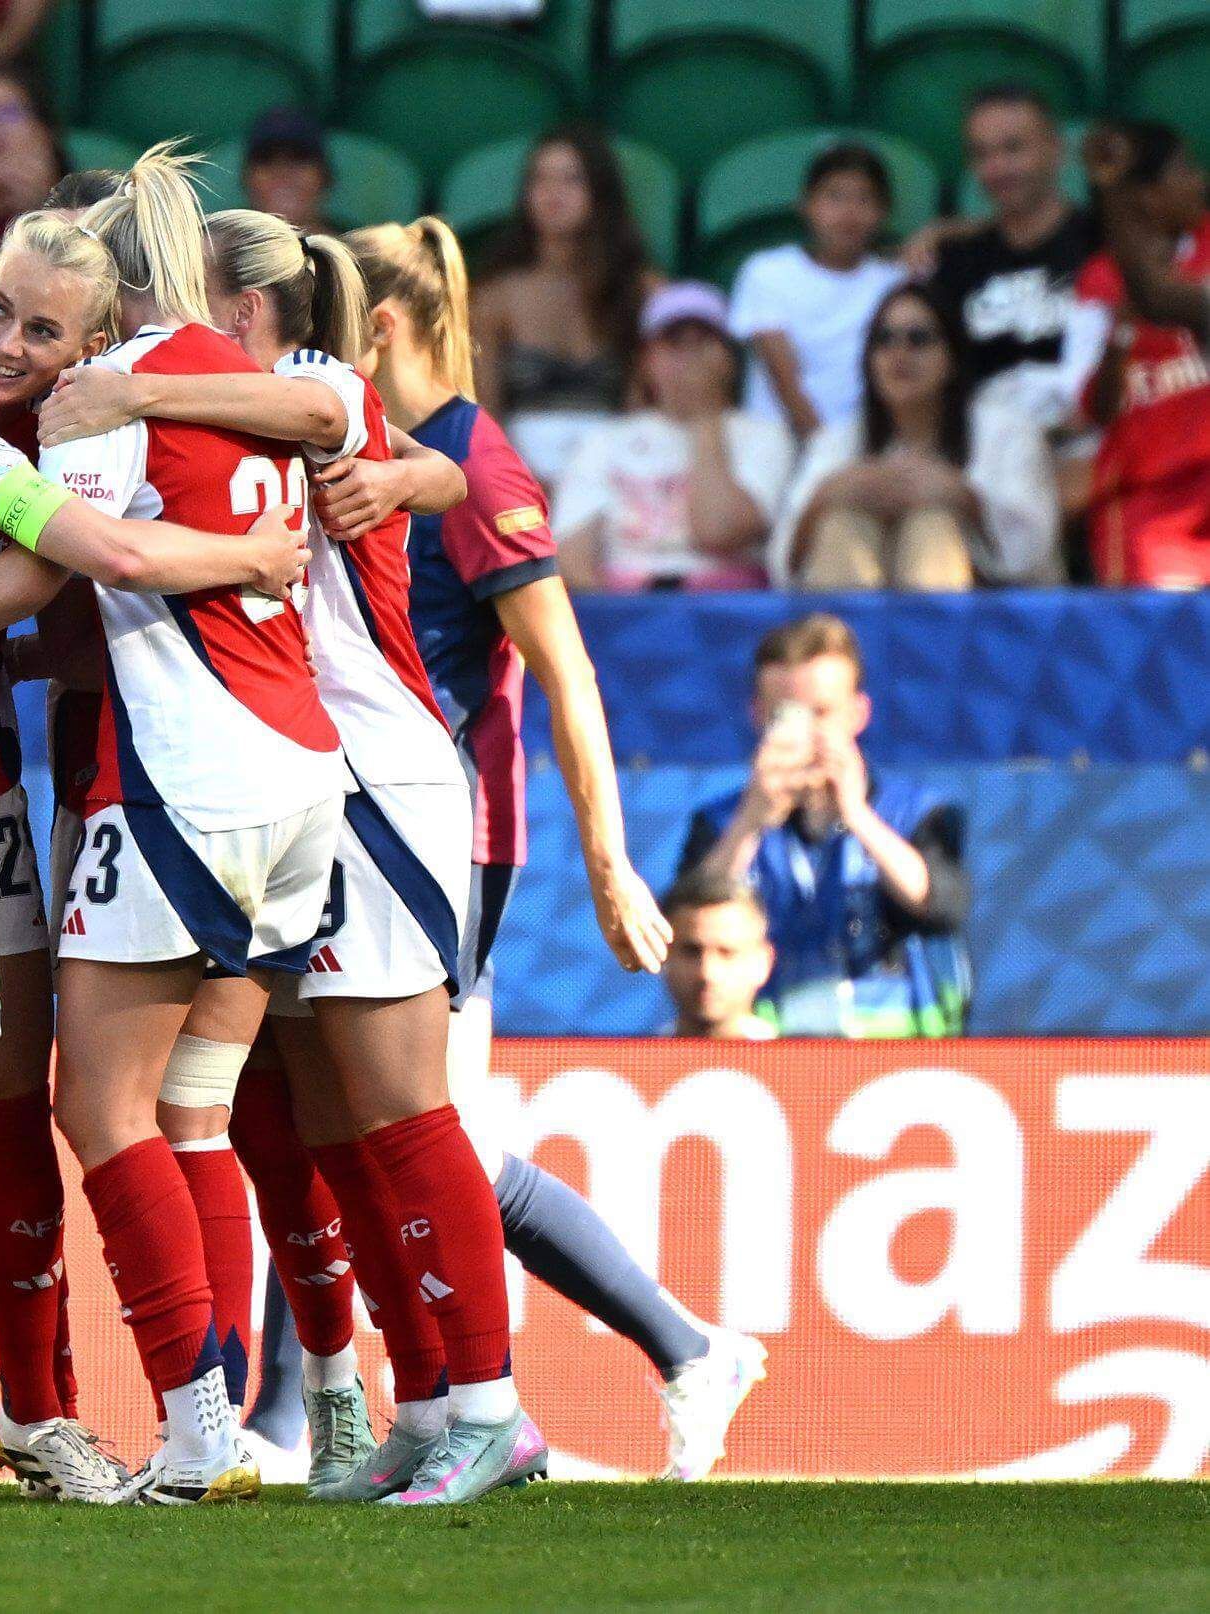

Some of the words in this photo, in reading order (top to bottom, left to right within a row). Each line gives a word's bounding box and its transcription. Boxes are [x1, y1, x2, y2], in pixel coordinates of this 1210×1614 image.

[62, 473, 102, 485] VISIT
[3, 496, 28, 538] SPECT
[480, 1066, 1210, 1342] maz
